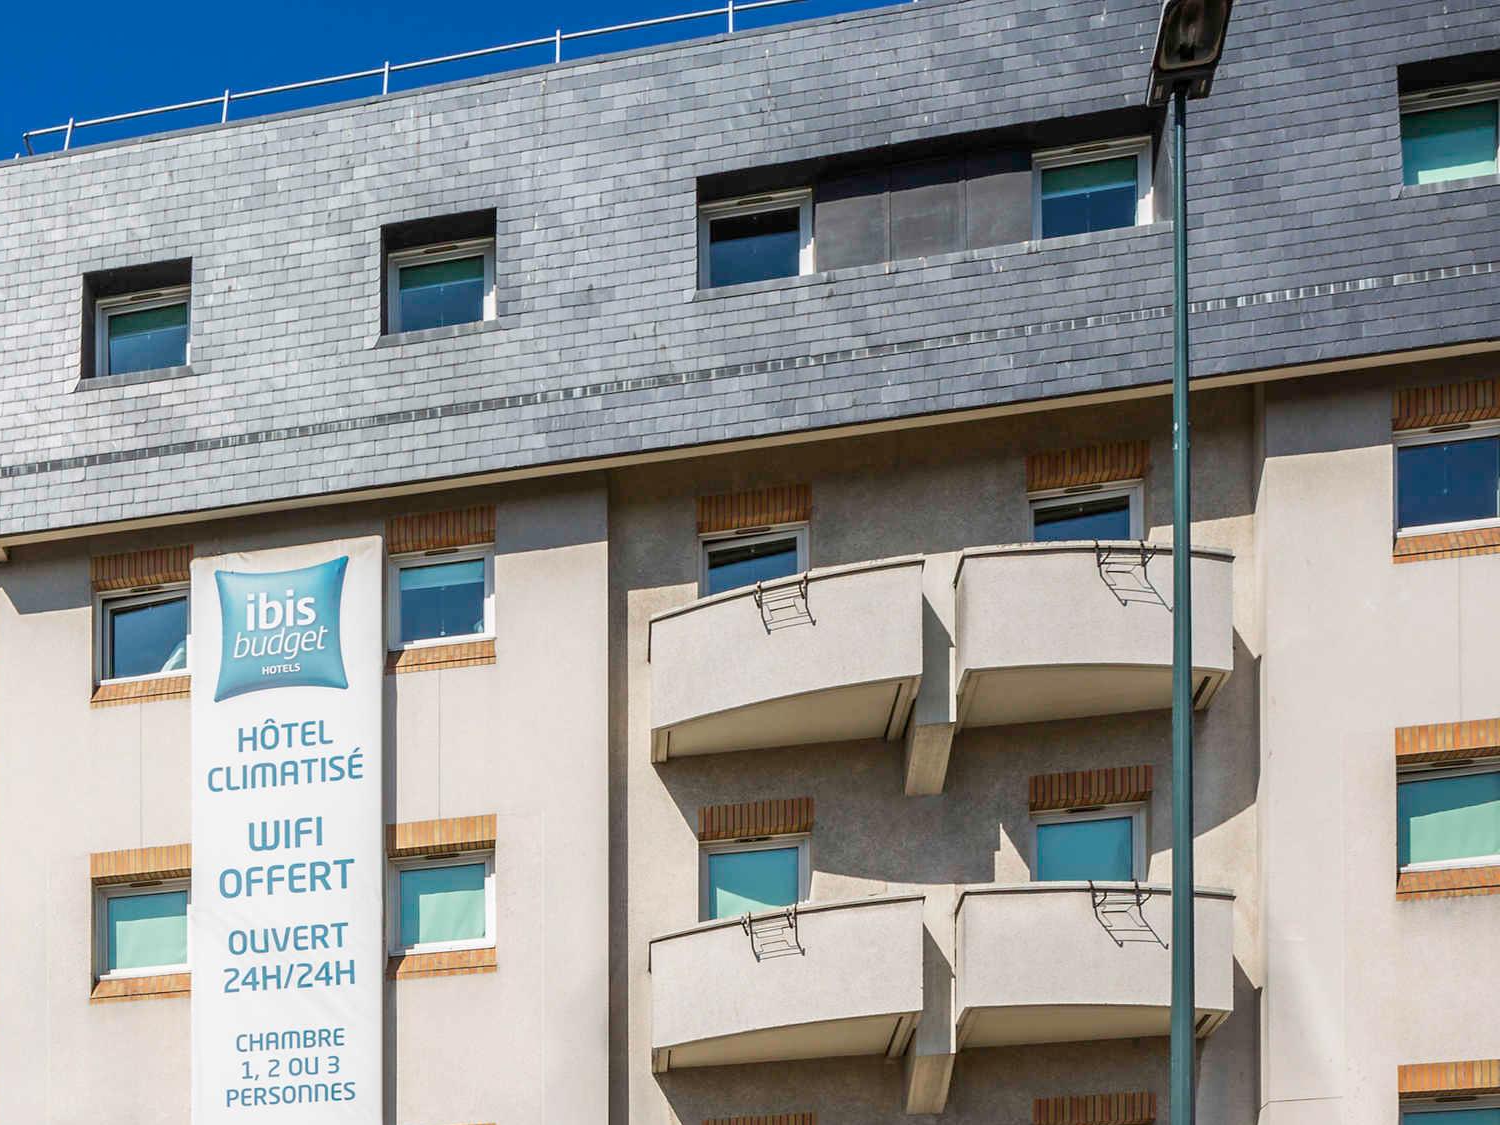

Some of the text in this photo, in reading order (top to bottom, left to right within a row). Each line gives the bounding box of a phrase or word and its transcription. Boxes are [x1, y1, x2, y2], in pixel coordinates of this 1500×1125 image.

[246, 589, 316, 632] ibis
[233, 625, 328, 660] budget
[262, 663, 301, 675] HOTELS
[238, 718, 333, 753] HÔTEL
[208, 747, 364, 793] CLIMATISÉ
[248, 816, 323, 852] WIFI
[219, 858, 355, 899] OFFERT
[228, 922, 349, 956] OUVERT
[223, 960, 356, 994] 24H/24H
[236, 1028, 346, 1053] CHAMBRE
[241, 1055, 340, 1081] 1, 2 OU 3
[226, 1082, 357, 1108] PERSONNES
